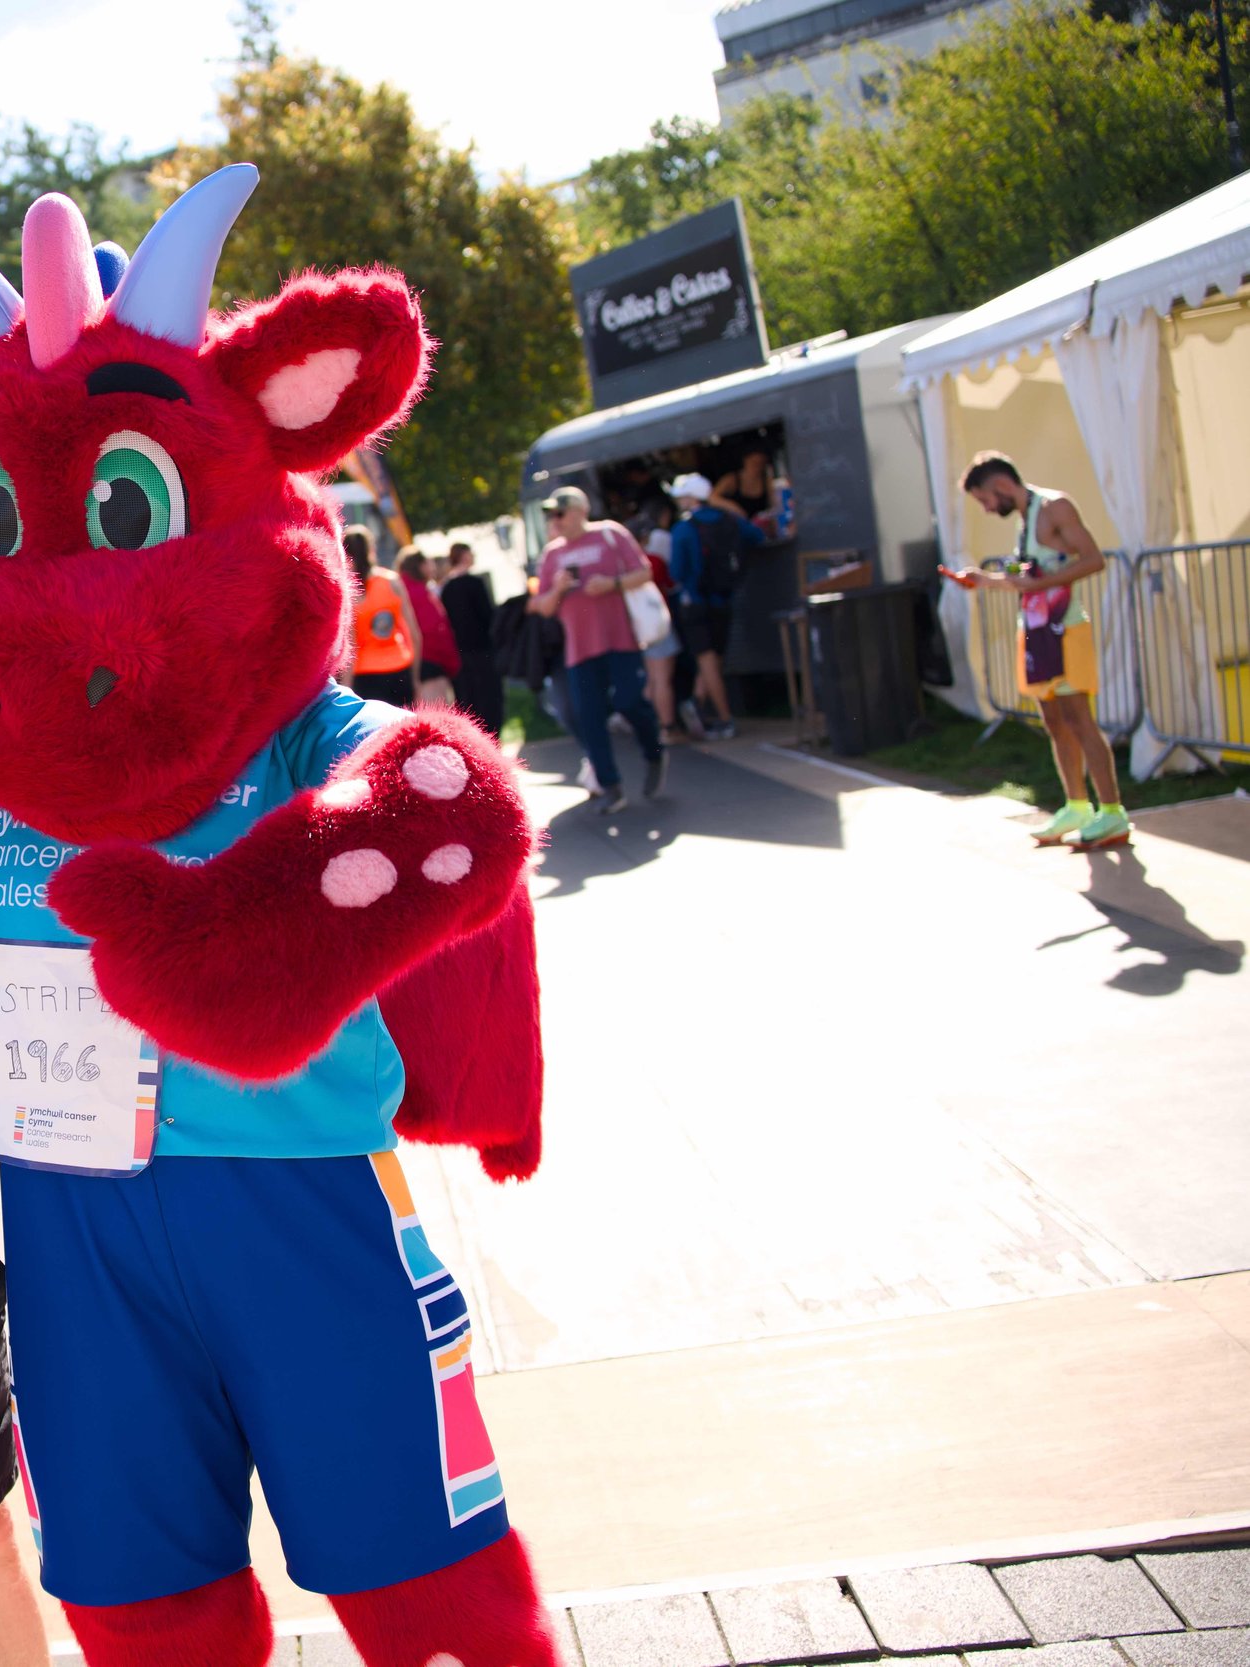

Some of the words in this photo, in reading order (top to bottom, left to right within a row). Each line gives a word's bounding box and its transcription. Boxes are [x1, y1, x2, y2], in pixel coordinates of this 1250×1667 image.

[671, 266, 733, 307] Cakes
[5, 1039, 100, 1083] 1966
[29, 1107, 63, 1119] ymchwil
[64, 1111, 97, 1122] canser
[28, 1118, 54, 1128] cymru
[26, 1128, 53, 1139] cancer
[54, 1131, 92, 1143] research
[25, 1139, 50, 1149] wales
